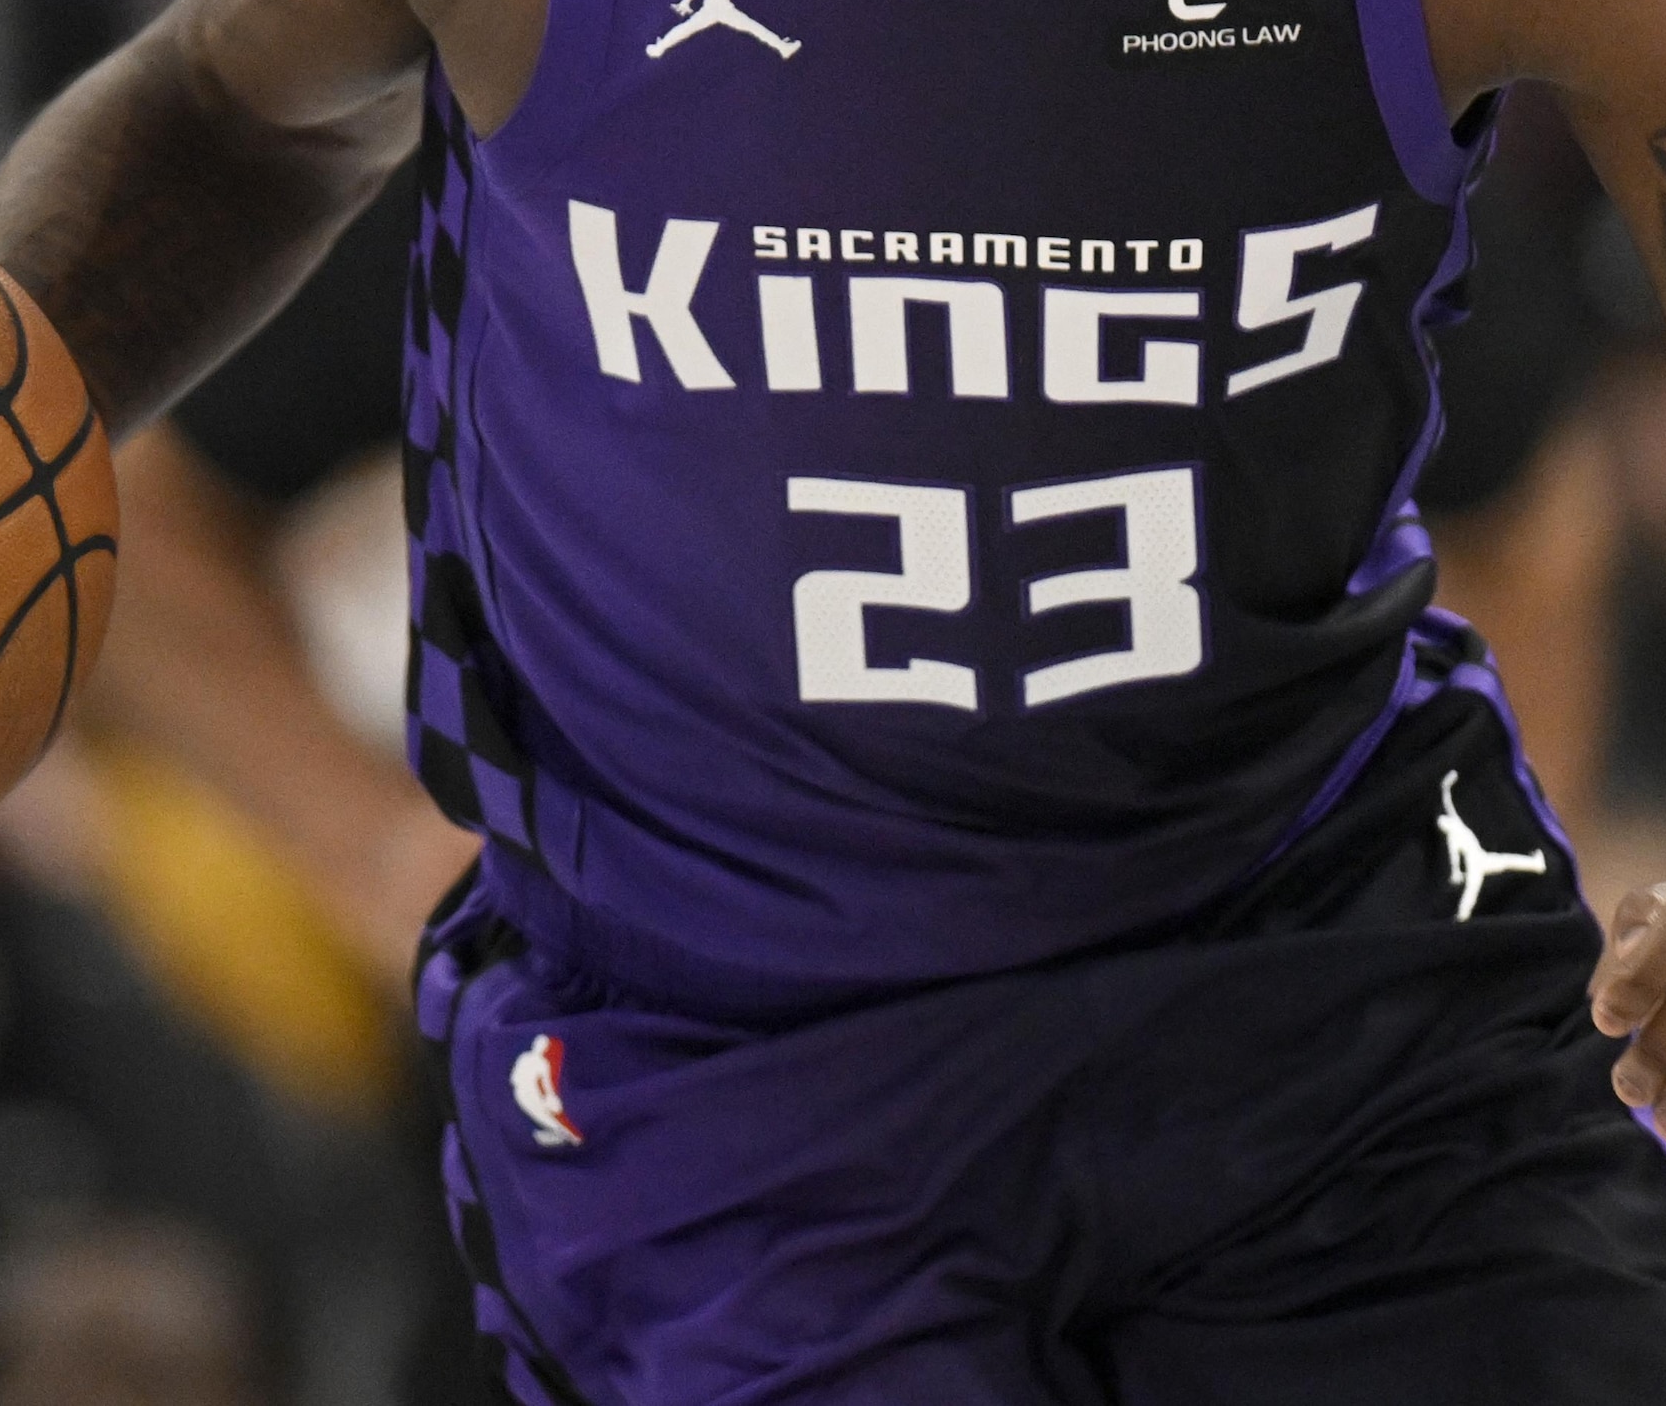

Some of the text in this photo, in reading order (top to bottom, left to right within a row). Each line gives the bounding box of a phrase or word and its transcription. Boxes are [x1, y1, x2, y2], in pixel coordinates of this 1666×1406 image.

[1122, 23, 1302, 54] PHOONG LAW
[566, 198, 1380, 406] KINGS
[752, 225, 1204, 272] SACRAMENTO
[785, 465, 1205, 712] 23
